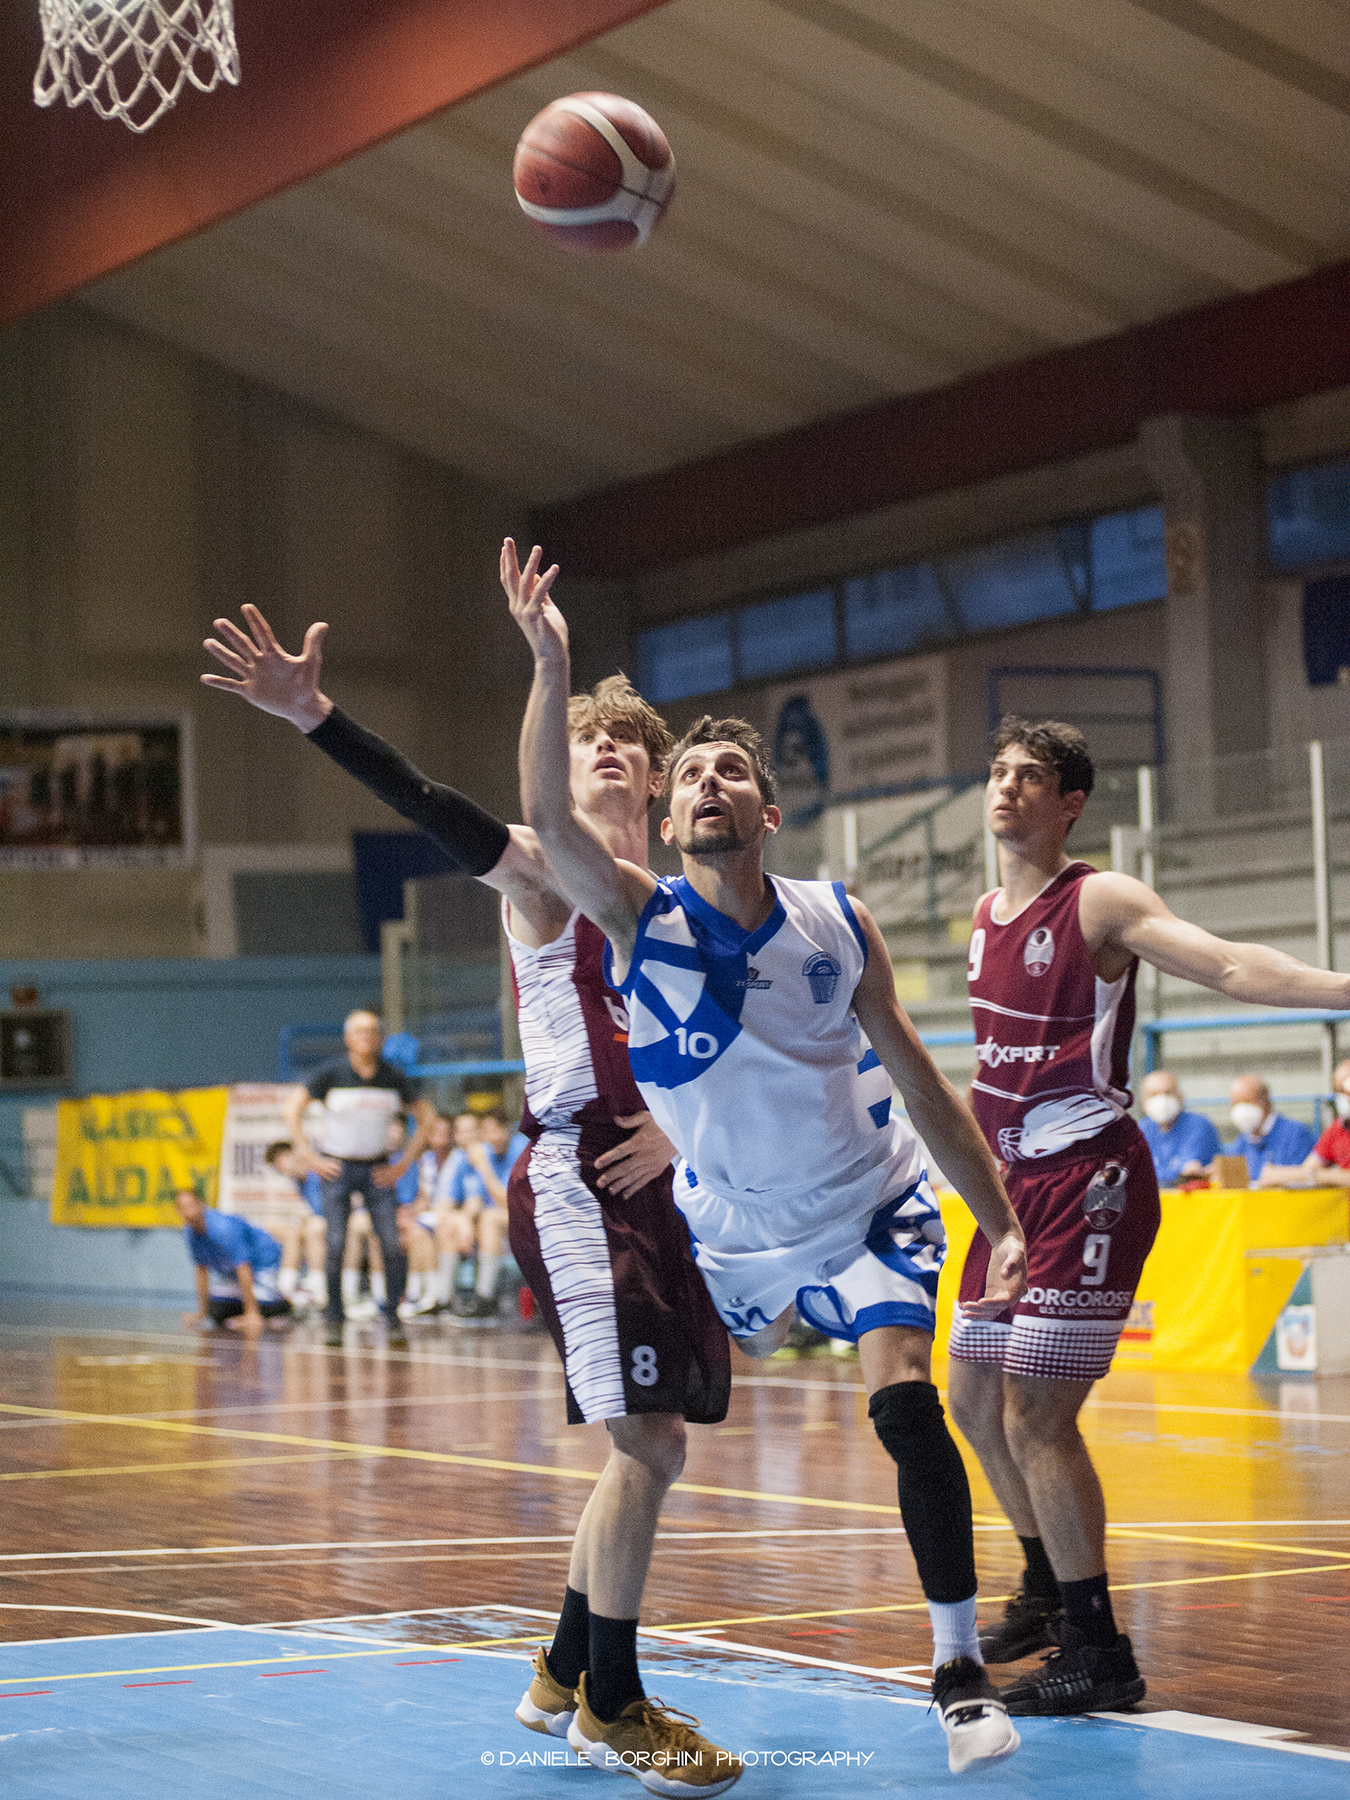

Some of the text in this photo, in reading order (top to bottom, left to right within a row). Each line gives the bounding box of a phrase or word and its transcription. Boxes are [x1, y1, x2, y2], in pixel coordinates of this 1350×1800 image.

[967, 928, 986, 981] 9
[674, 1027, 719, 1059] 10
[1081, 1233, 1111, 1286] 9
[630, 1345, 659, 1387] 8
